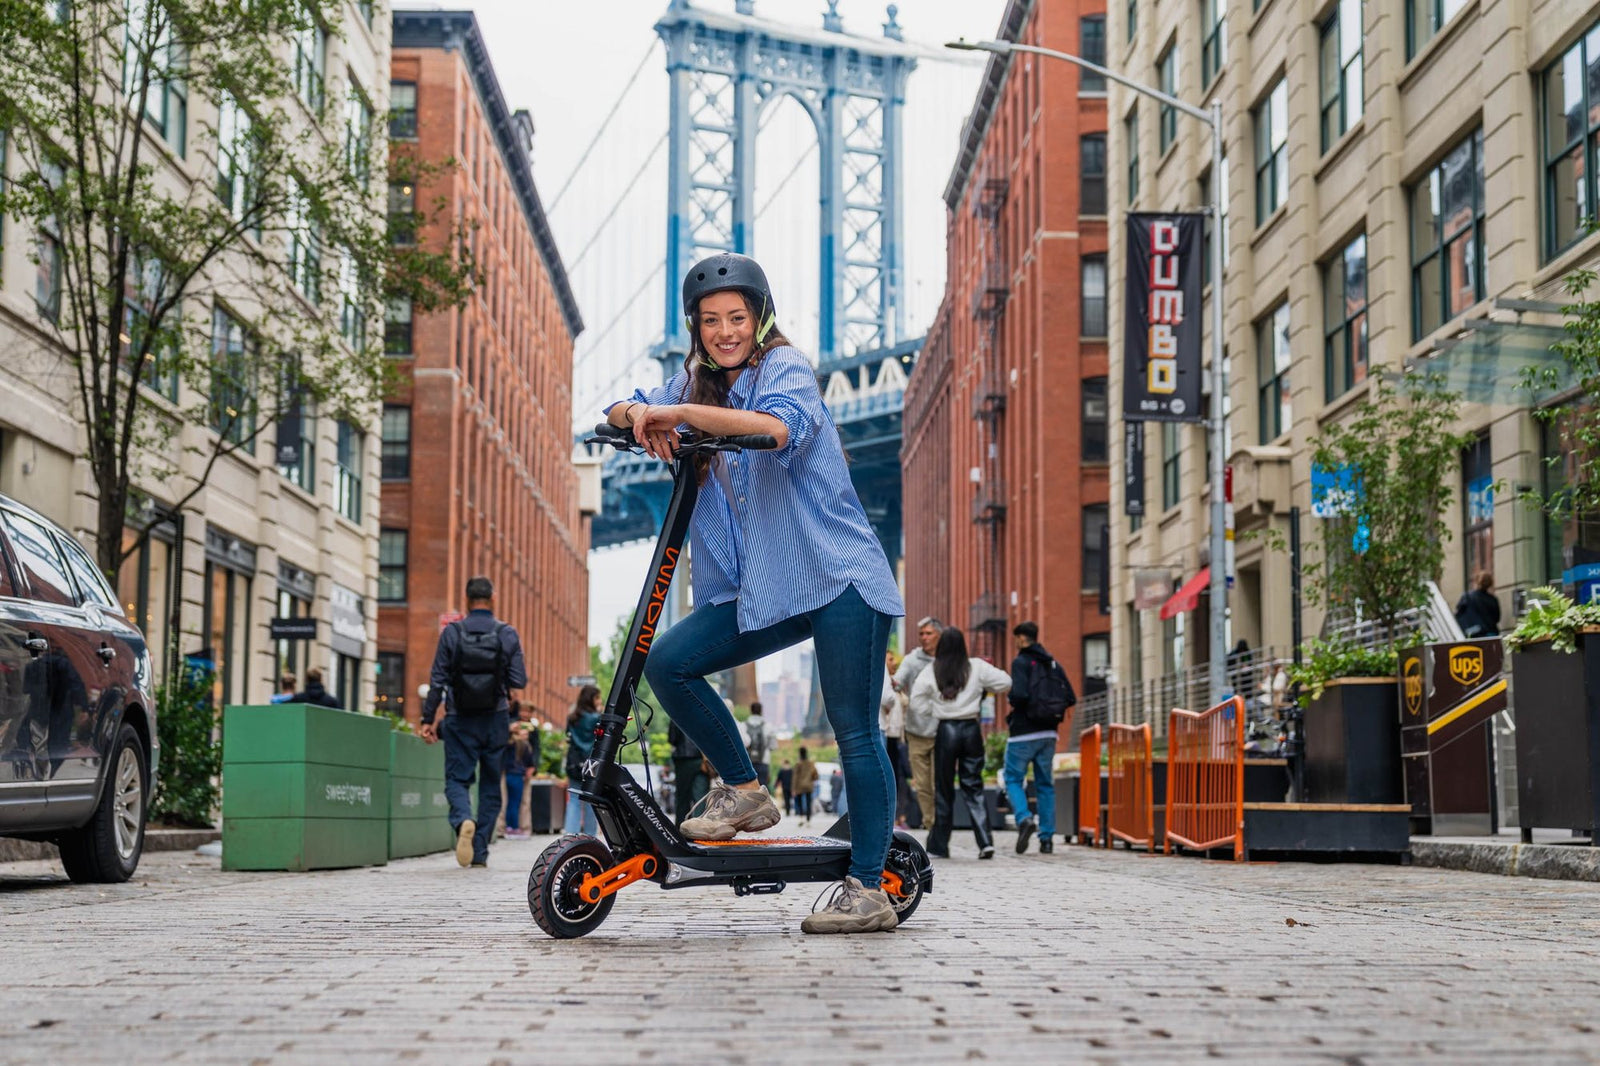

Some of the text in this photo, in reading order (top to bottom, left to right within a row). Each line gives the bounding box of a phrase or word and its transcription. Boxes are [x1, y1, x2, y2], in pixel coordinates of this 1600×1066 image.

[1147, 220, 1184, 395] DUMBO
[636, 546, 680, 655] INOKIM
[1453, 657, 1481, 679] ups
